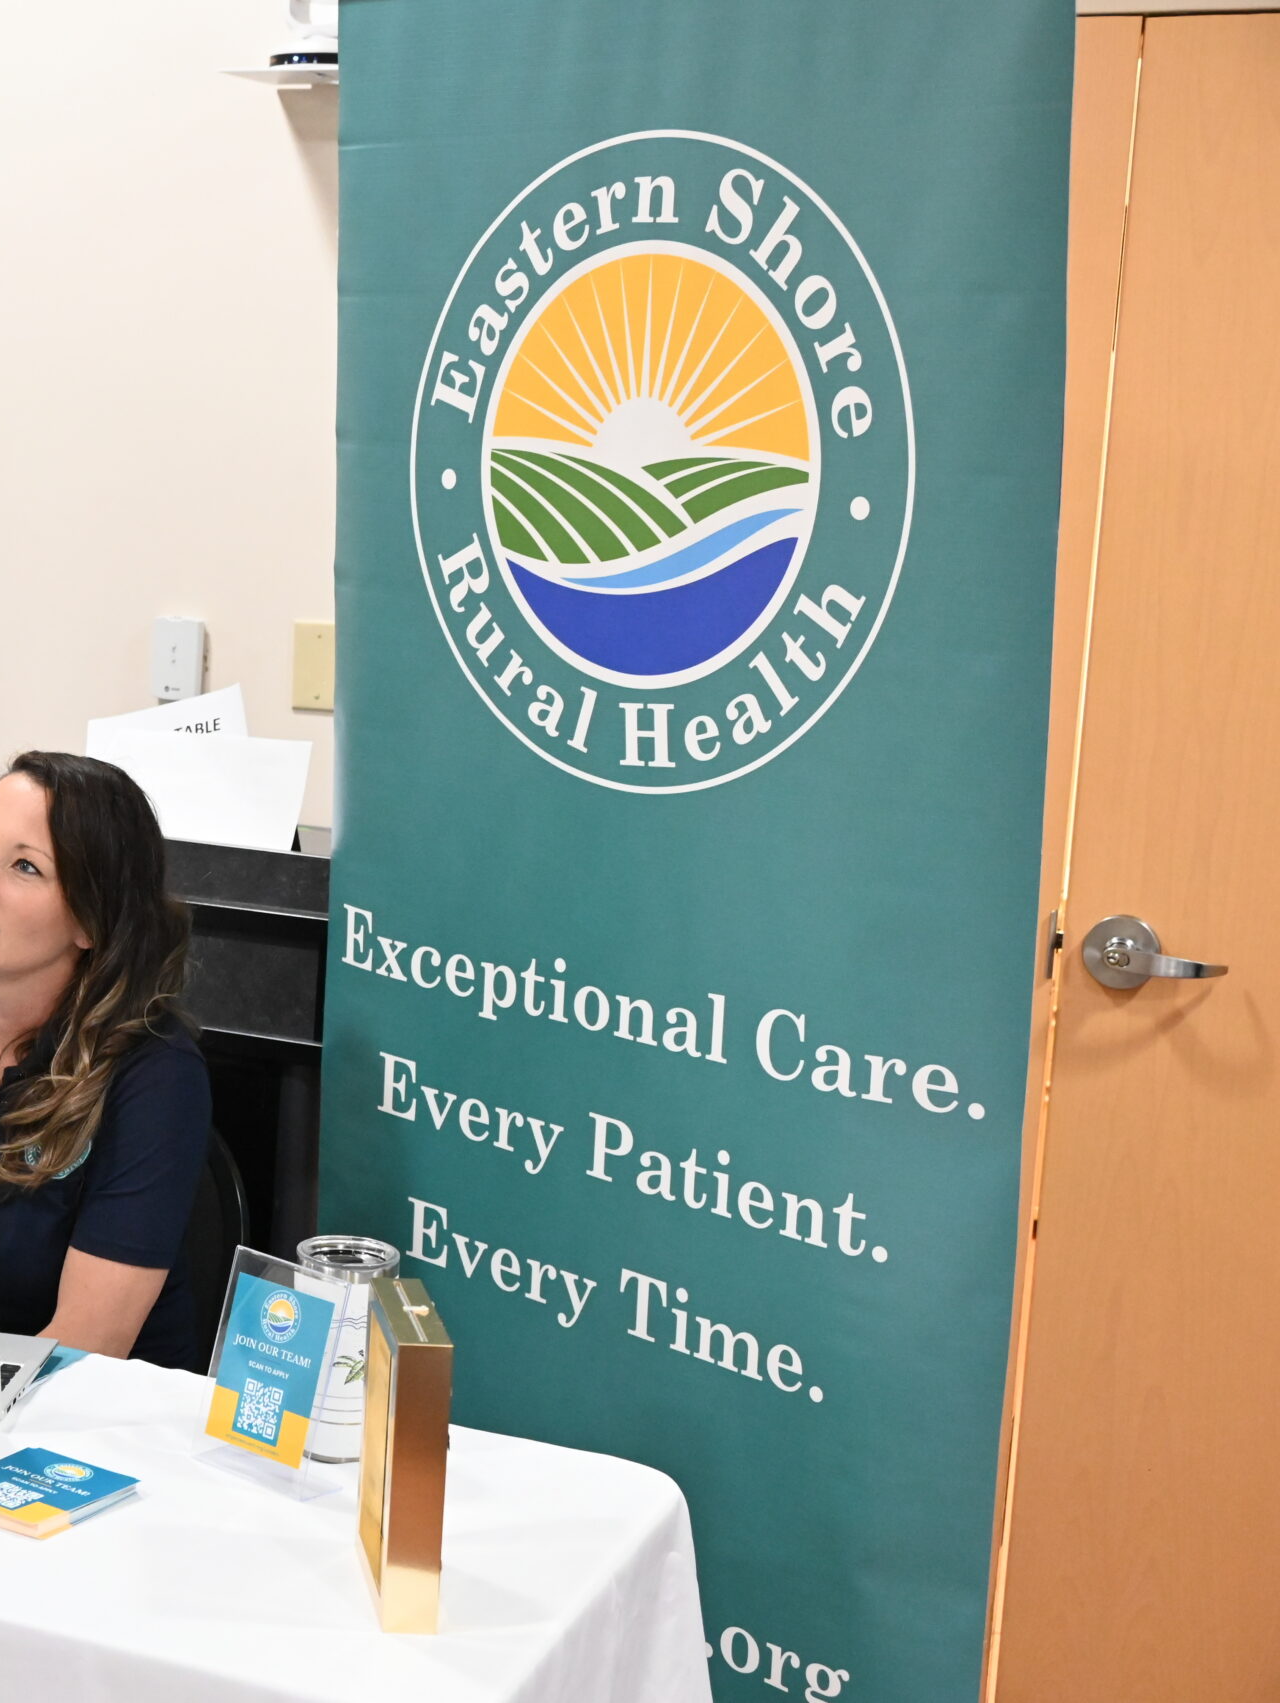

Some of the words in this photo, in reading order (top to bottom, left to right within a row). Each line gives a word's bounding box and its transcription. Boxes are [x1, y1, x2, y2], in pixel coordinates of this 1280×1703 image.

[431, 175, 680, 425] Eastern
[704, 168, 873, 440] Shore
[437, 532, 598, 754] Rural
[618, 583, 867, 768] Health
[341, 903, 728, 1065] Exceptional
[755, 1008, 986, 1120] Care.
[377, 1051, 564, 1175] Every
[586, 1111, 888, 1263] Patient.
[233, 1333, 257, 1350] JOIN
[258, 1342, 279, 1357] OUR
[281, 1349, 312, 1369] TEAM!
[248, 1360, 264, 1372] SCAN
[263, 1365, 272, 1374] TO
[272, 1369, 290, 1380] APPLY
[406, 1197, 597, 1328] Every
[619, 1268, 824, 1403] Time.
[1, 1464, 30, 1477] JOIN
[29, 1473, 56, 1486] OUR
[55, 1482, 91, 1497] TEAM!
